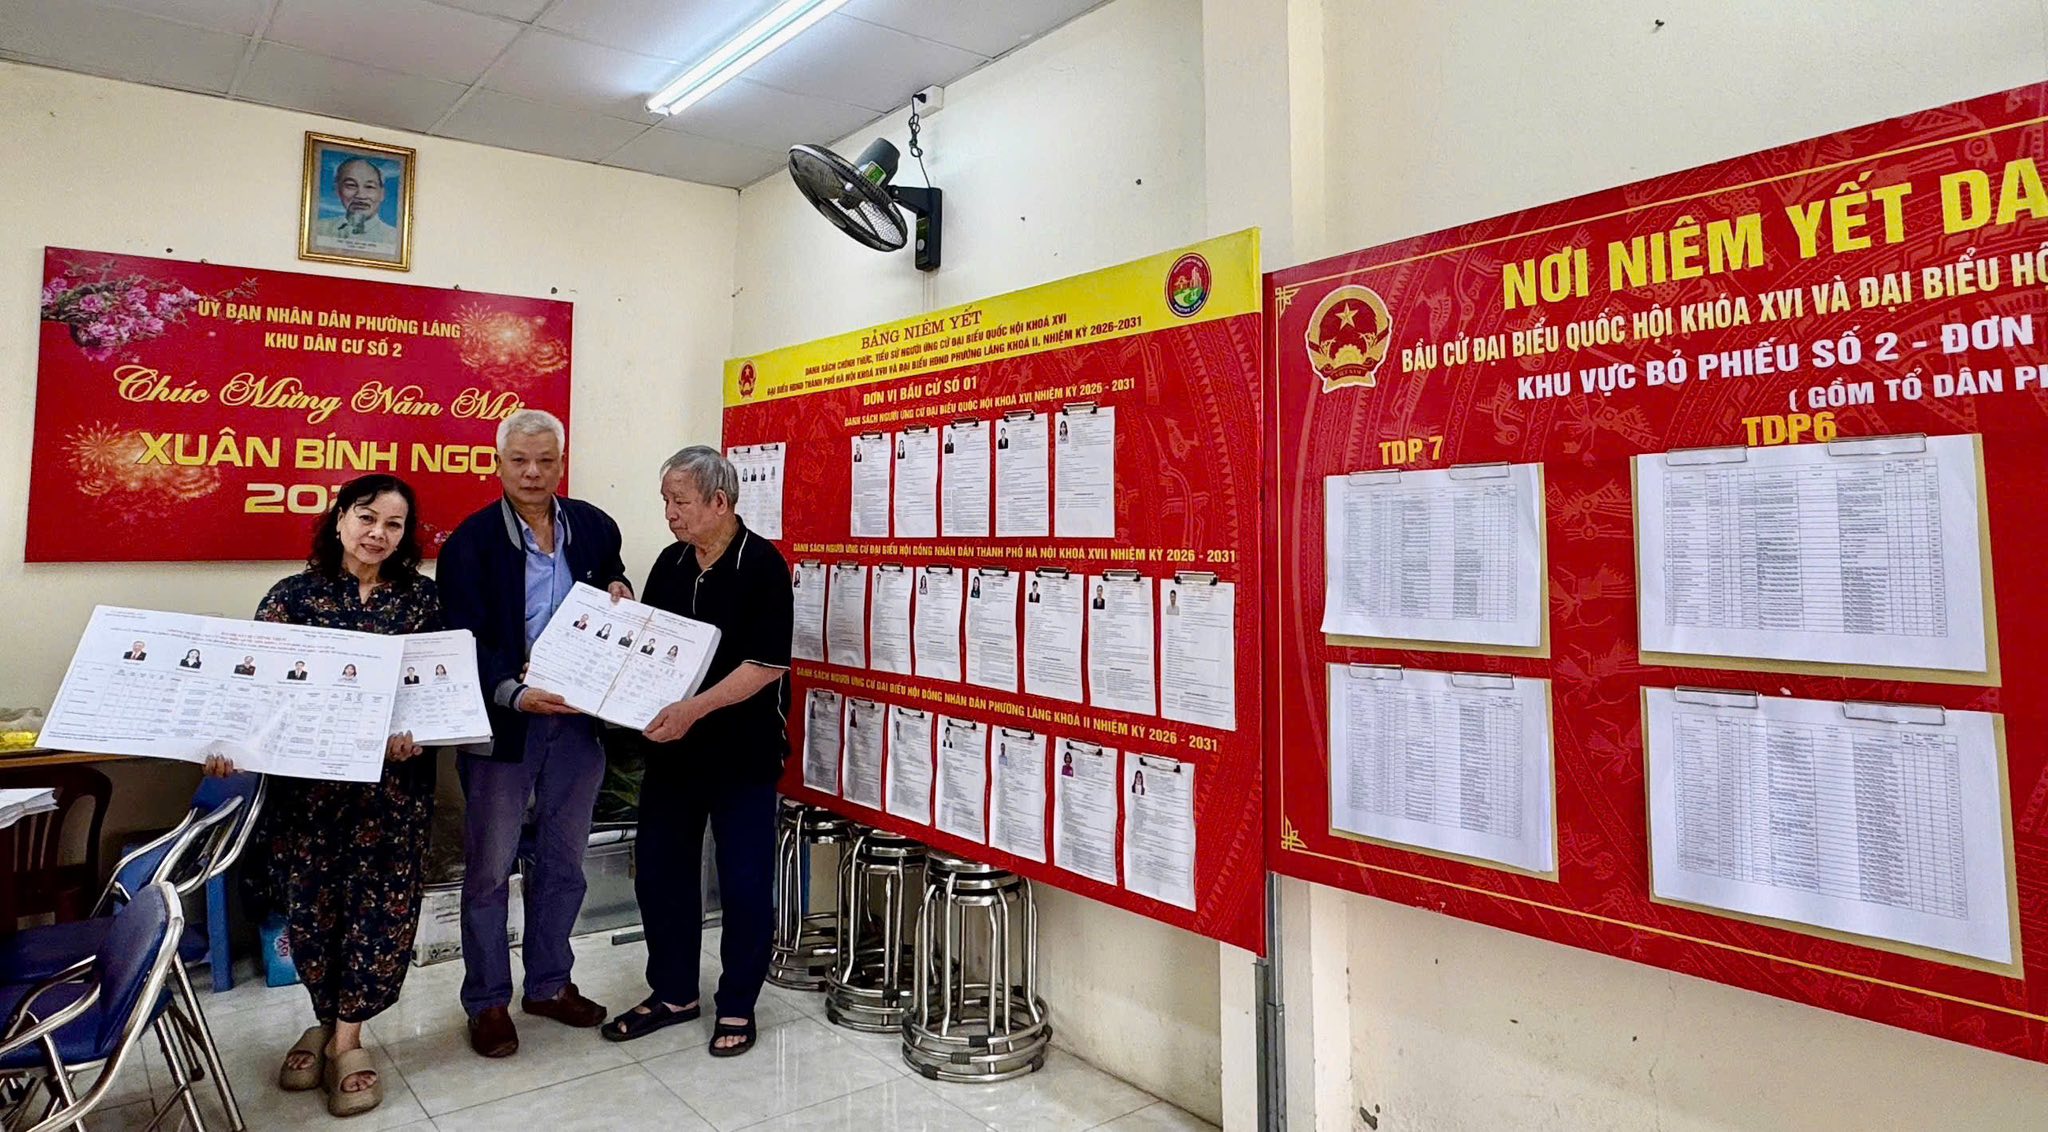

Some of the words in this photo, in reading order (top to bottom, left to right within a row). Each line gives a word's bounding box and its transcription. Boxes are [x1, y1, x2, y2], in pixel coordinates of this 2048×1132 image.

[1502, 245, 1589, 310] NƠI
[1608, 213, 1764, 292] NIÊM
[1785, 170, 1912, 259] YẾT
[226, 303, 262, 321] BAN
[266, 306, 313, 325] NHÂN
[317, 309, 351, 329] DÂN
[355, 314, 418, 335] PHƯỜNG
[422, 320, 461, 338] LÁNG
[861, 329, 899, 349] BẢNG
[904, 318, 944, 341] NIÊM
[949, 305, 983, 329] YẾT
[1052, 313, 1067, 325] XVI
[1402, 338, 1437, 373] BẦU
[1443, 332, 1470, 365] CỬ
[1473, 334, 1506, 366] ĐẠI
[1512, 316, 1559, 358] BIỂU
[1566, 307, 1626, 352] QUỐC
[1633, 303, 1673, 343] HỘI
[1681, 293, 1751, 333] KHÓA
[1758, 288, 1804, 323] XVI
[1811, 275, 1851, 315] VÀ
[1859, 271, 1913, 312] ĐẠI
[1922, 247, 2000, 300] BIỂU
[264, 331, 299, 349] KHU
[303, 333, 337, 352] DÂN
[341, 338, 365, 354] CƯ
[367, 337, 389, 356] SỐ
[392, 343, 402, 358] 2
[984, 343, 1005, 356] LÁNG
[1043, 329, 1073, 345] NHIỆM
[1090, 315, 1142, 336] 2026-2031
[1517, 371, 1571, 401] KHU
[1579, 363, 1636, 397] VỰC
[1646, 349, 1688, 386] BỎ
[1698, 337, 1799, 381] PHIẾU
[1811, 325, 1862, 368] SỐ
[1875, 332, 1899, 362] 2
[1940, 314, 2034, 355] ĐƠN
[113, 364, 211, 404] Chúc
[219, 372, 343, 425] Mừng
[351, 380, 444, 417] Năm
[863, 391, 885, 406] ĐƠN
[887, 391, 897, 404] VỊ
[925, 377, 940, 397] CỬ
[943, 375, 960, 393] SỐ
[963, 376, 977, 390] 01
[1018, 391, 1033, 404] XVI
[1034, 386, 1063, 401] NHIỆM
[1080, 382, 1103, 395] 2026
[1111, 377, 1135, 391] 2031
[1808, 377, 1875, 409] GỒM
[1884, 367, 1922, 401] TỔ
[1933, 367, 2003, 398] DÂN
[136, 426, 281, 468] XUÂN
[295, 431, 398, 472] BÍNH
[1742, 411, 1837, 446] TDP6
[1379, 438, 1423, 466] TDP
[1429, 435, 1443, 460] 7
[958, 544, 974, 557] DÂN
[977, 544, 1004, 558] THÀNH
[1040, 545, 1056, 559] NỘI
[1088, 548, 1107, 560] XVII
[1110, 546, 1146, 561] NHIỆM
[1166, 549, 1195, 562] 2026
[1207, 550, 1236, 563] 2031
[1027, 706, 1051, 720] LÁNG
[1093, 717, 1128, 736] NHIỆM
[1149, 728, 1177, 744] 2026
[1189, 735, 1218, 751] 2031
